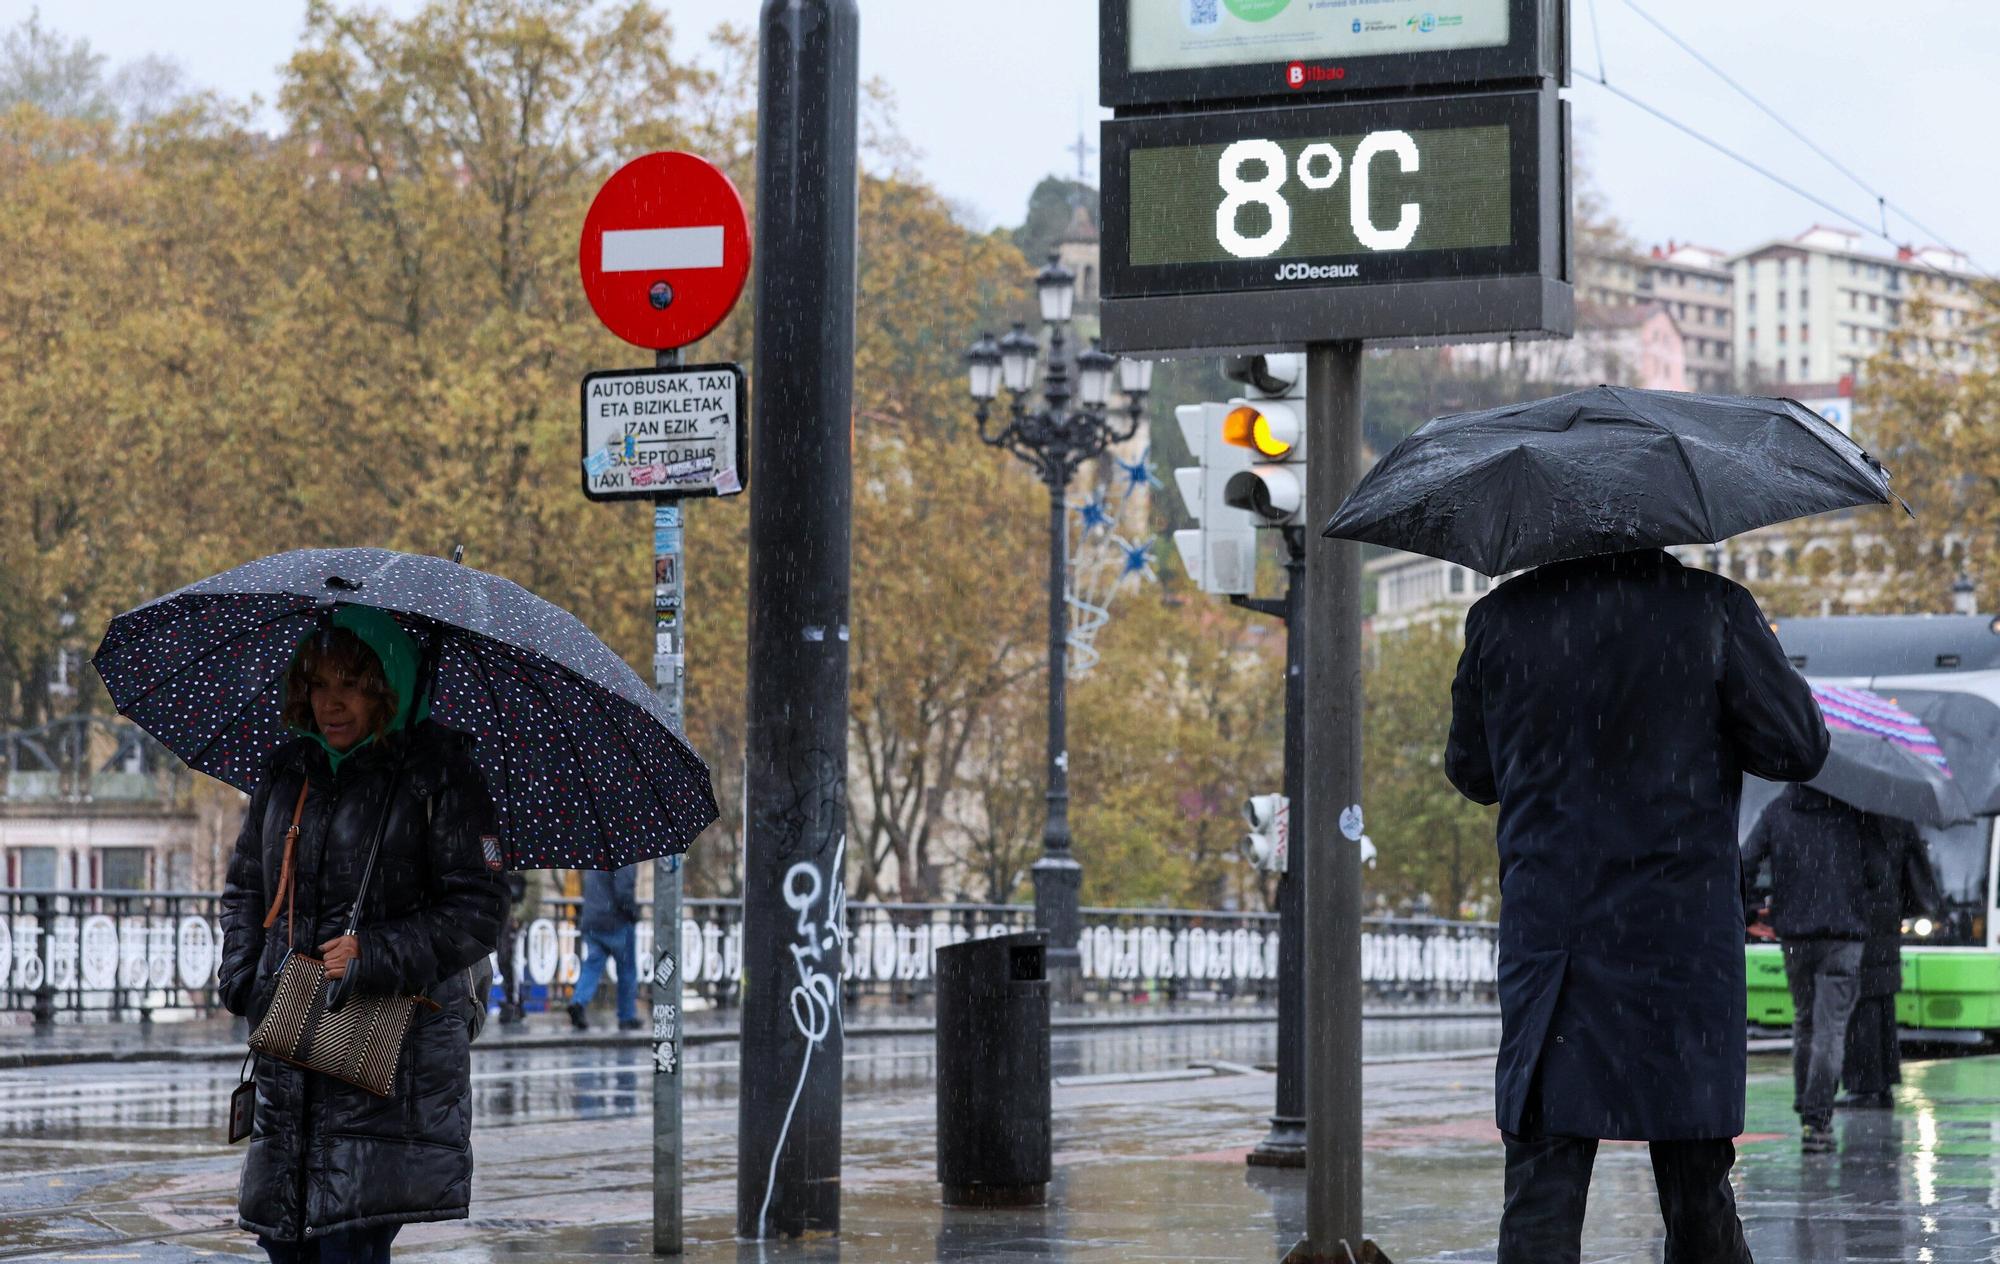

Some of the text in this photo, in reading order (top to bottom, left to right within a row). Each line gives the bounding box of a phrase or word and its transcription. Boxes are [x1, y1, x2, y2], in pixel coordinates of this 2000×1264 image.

[1287, 62, 1345, 87] Bilbao
[1216, 130, 1420, 258] 8°C
[1275, 263, 1359, 281] JCDecaux
[592, 376, 731, 398] AUTOBUSAK, TAXI
[601, 397, 723, 417] ETA BIZIKLETAK
[624, 419, 698, 435] IZAN EZIK
[593, 473, 624, 488] TAXI
[654, 1024, 675, 1038] BRU
